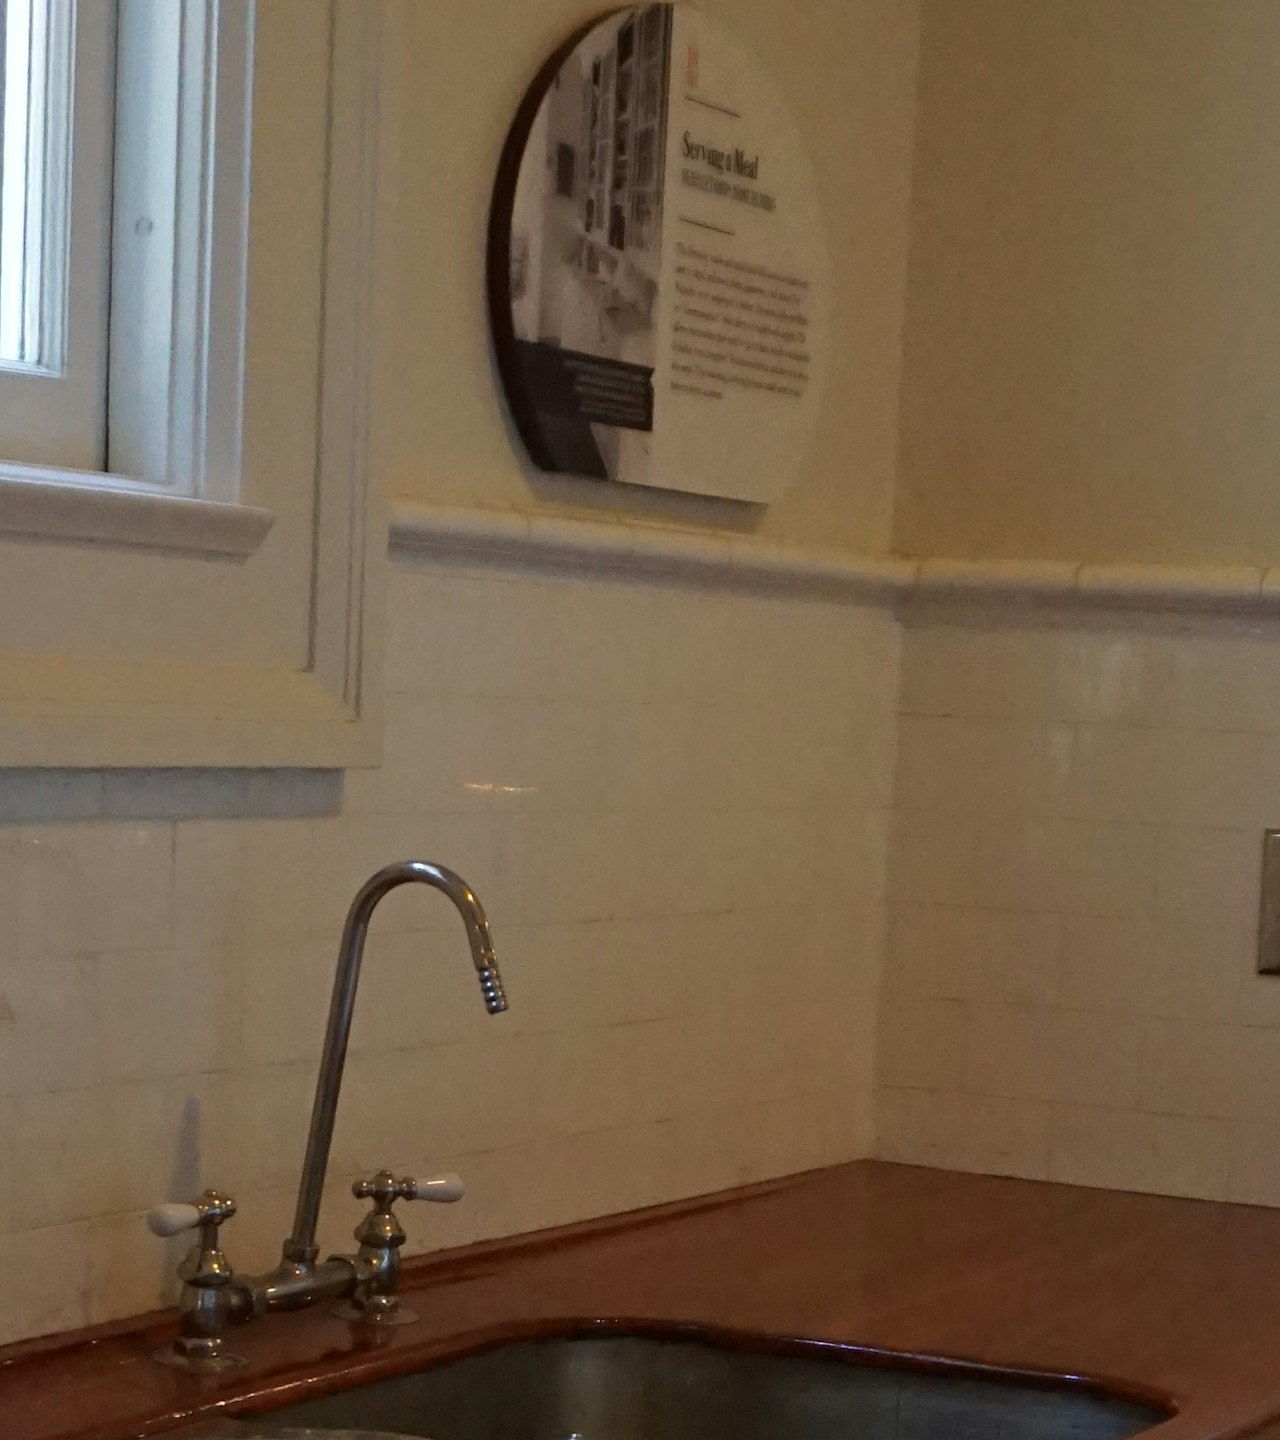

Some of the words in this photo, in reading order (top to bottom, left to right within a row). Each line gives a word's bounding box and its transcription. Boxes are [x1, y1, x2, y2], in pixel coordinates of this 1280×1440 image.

[682, 130, 724, 173] Serving
[724, 152, 732, 172] a
[734, 147, 759, 180] Meal
